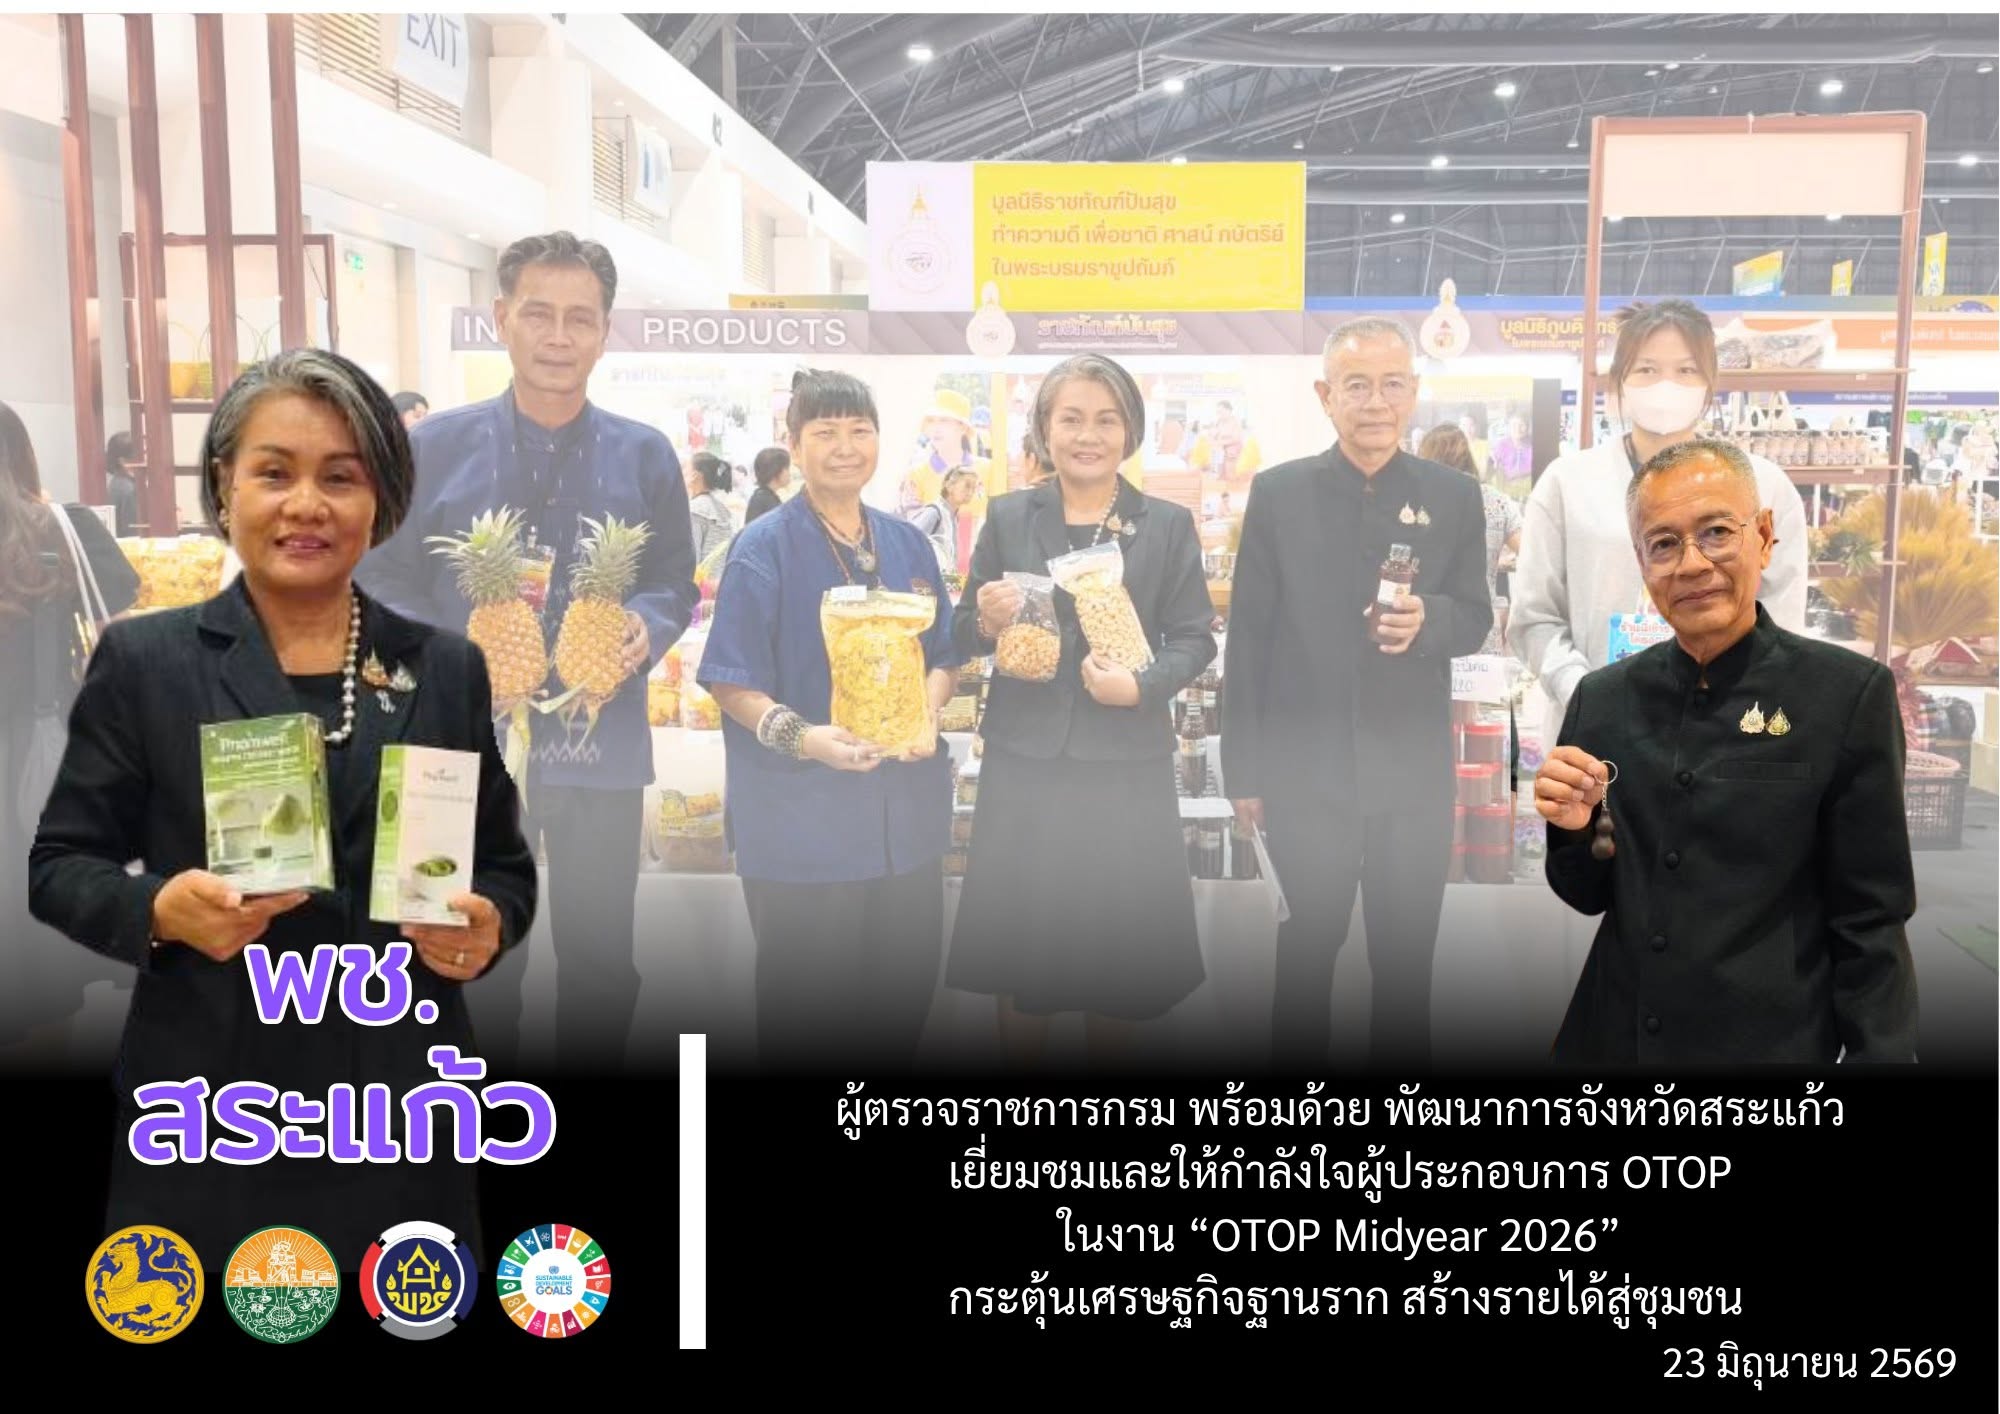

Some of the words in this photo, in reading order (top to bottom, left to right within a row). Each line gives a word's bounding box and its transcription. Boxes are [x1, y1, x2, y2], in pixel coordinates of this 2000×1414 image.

[992, 223, 1080, 243] ทำความดี
[1086, 220, 1157, 243] เพื่อชาติ
[1163, 223, 1214, 243] ศาสน์
[1219, 222, 1285, 243] กษัตริย์
[992, 257, 1176, 280] ในพระบรมราชูปถัมภ์
[643, 318, 847, 346] PRODUCTS
